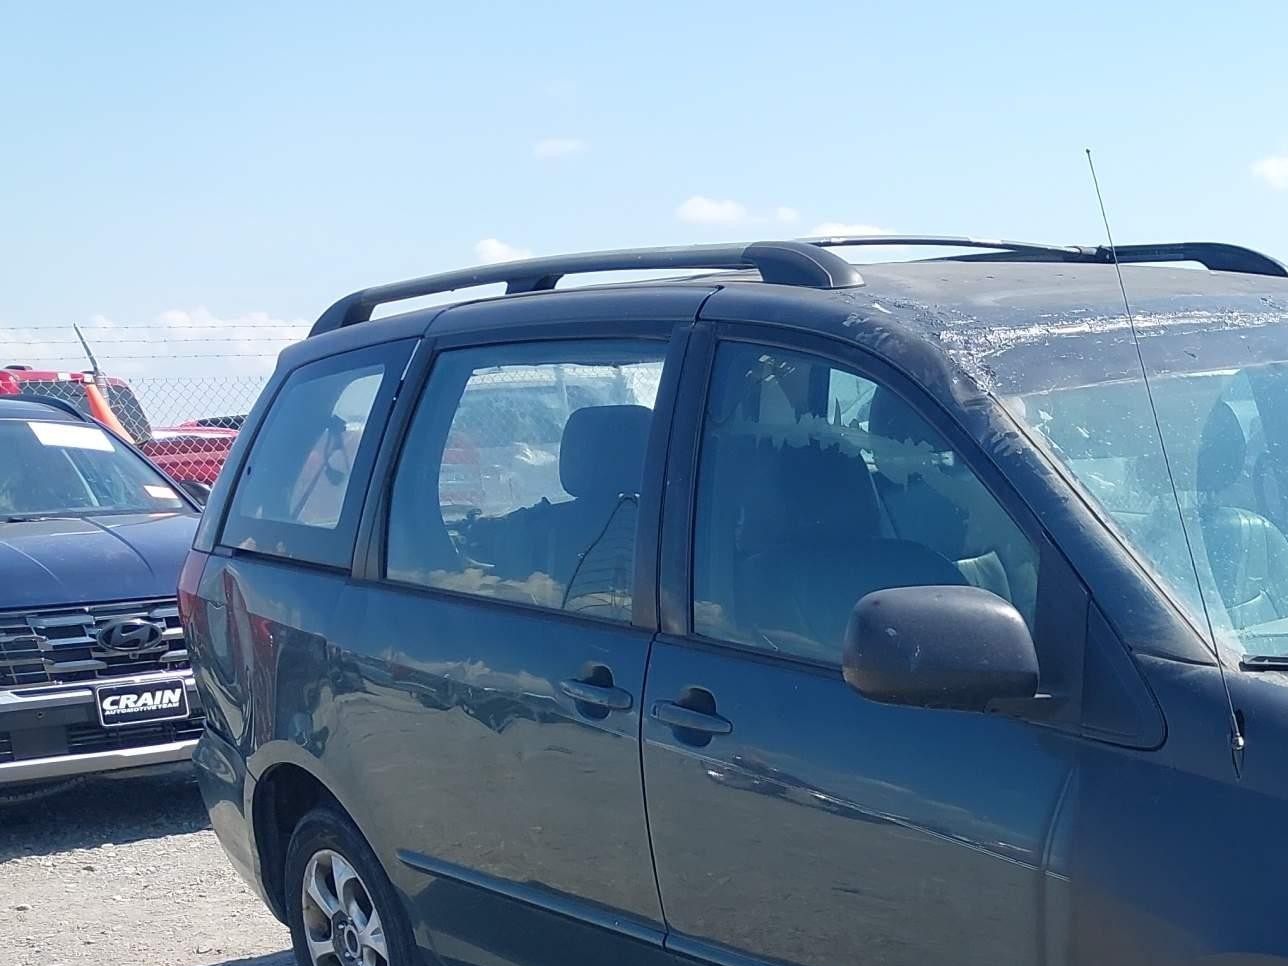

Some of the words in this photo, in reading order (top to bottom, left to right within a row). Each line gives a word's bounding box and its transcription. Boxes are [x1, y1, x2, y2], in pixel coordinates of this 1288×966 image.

[102, 688, 182, 711] CRAIN
[104, 706, 157, 716] AUTOMOTIVE
[157, 702, 180, 710] TEAM
